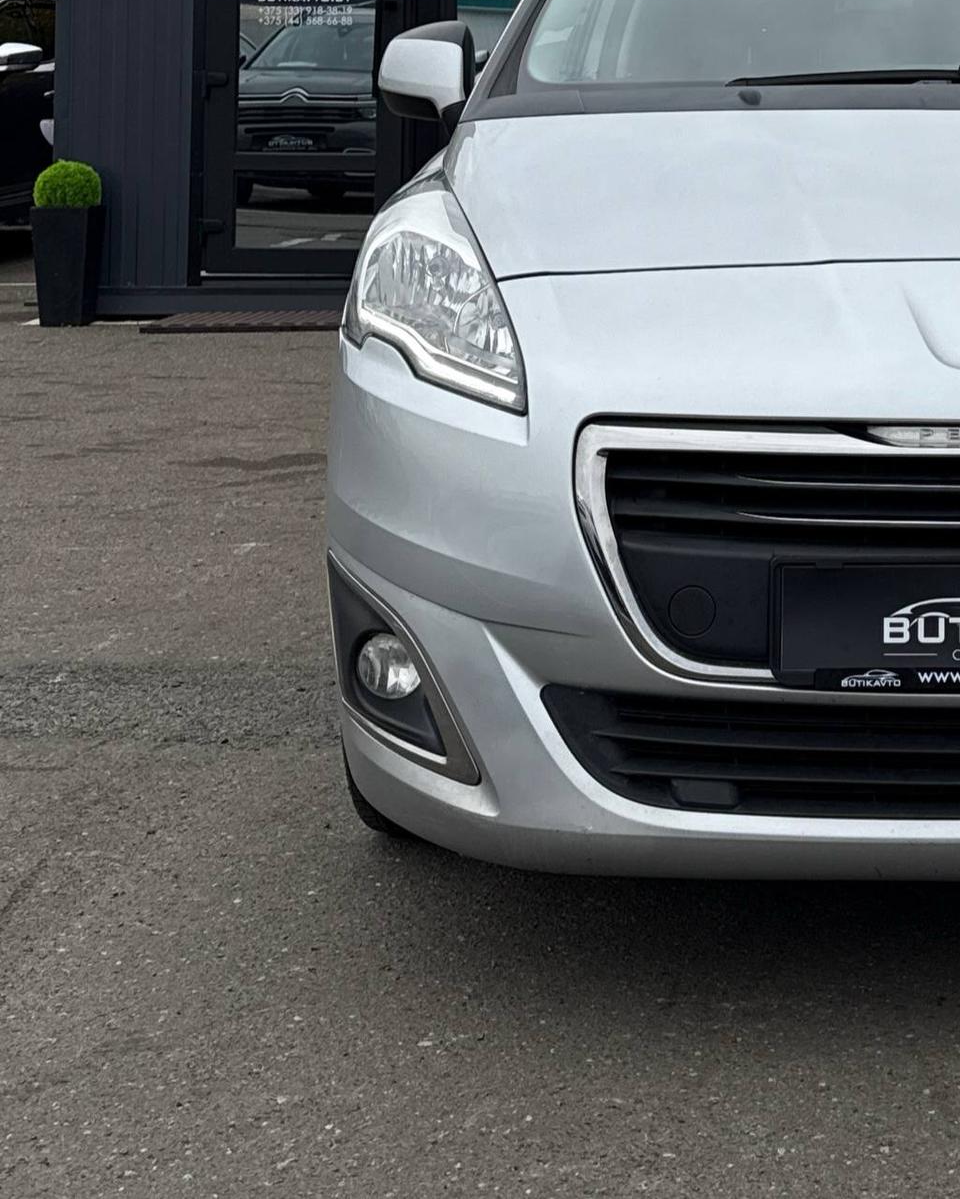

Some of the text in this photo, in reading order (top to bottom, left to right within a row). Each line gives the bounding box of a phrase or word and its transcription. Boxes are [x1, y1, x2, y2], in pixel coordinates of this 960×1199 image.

[259, 6, 282, 15] +375
[259, 16, 282, 26] +375
[840, 679, 901, 688] BUTIKAVTO
